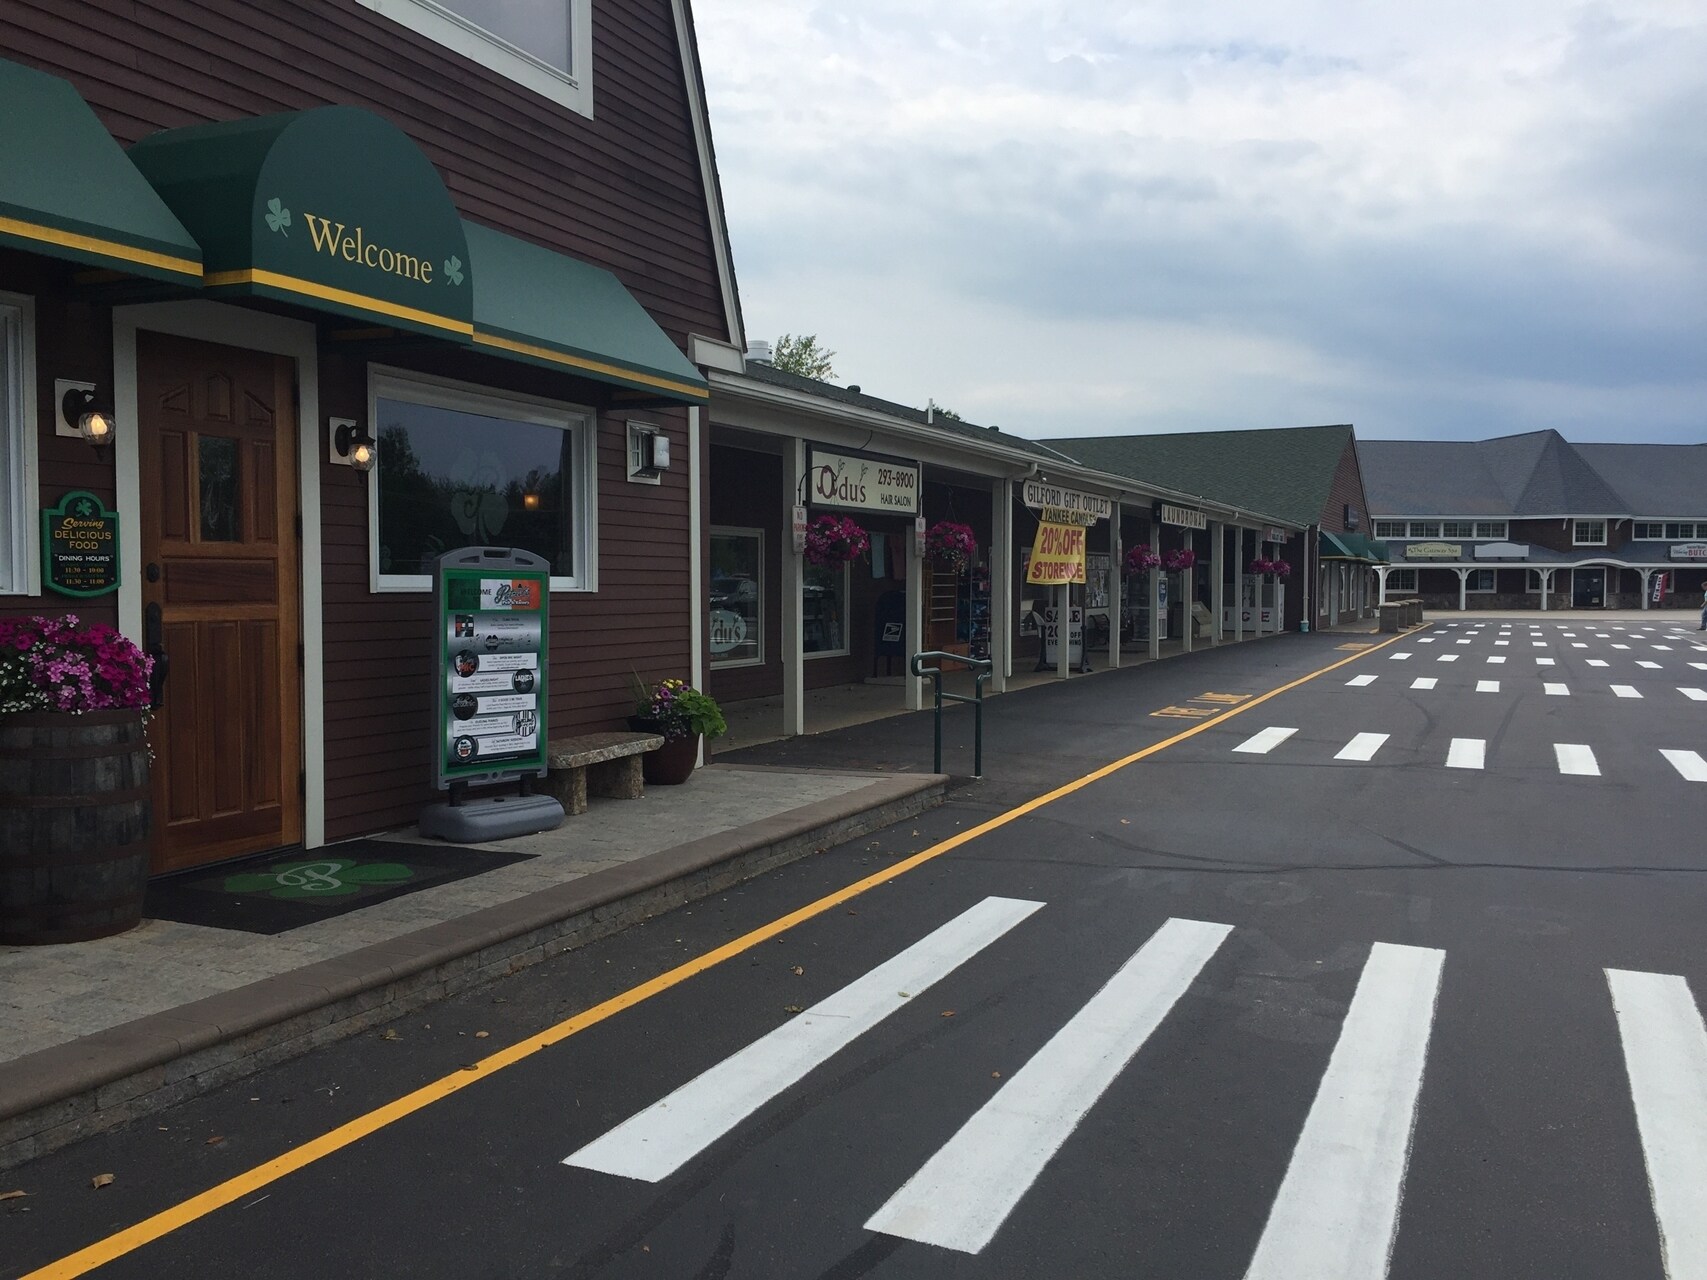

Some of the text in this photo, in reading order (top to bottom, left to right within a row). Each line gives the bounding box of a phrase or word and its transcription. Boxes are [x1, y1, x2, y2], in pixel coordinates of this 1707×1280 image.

[303, 212, 433, 284] Welcome
[878, 468, 914, 489] 293-8900
[880, 493, 912, 507] HAIR SALON
[1027, 484, 1109, 515] GILFORD GIFT OUTLET
[61, 517, 104, 529] Serving
[1044, 507, 1070, 523] YANKEE
[1163, 505, 1206, 528] LAUNDROMAT
[54, 530, 112, 540] DELICIOUS
[69, 541, 99, 550] FOOD
